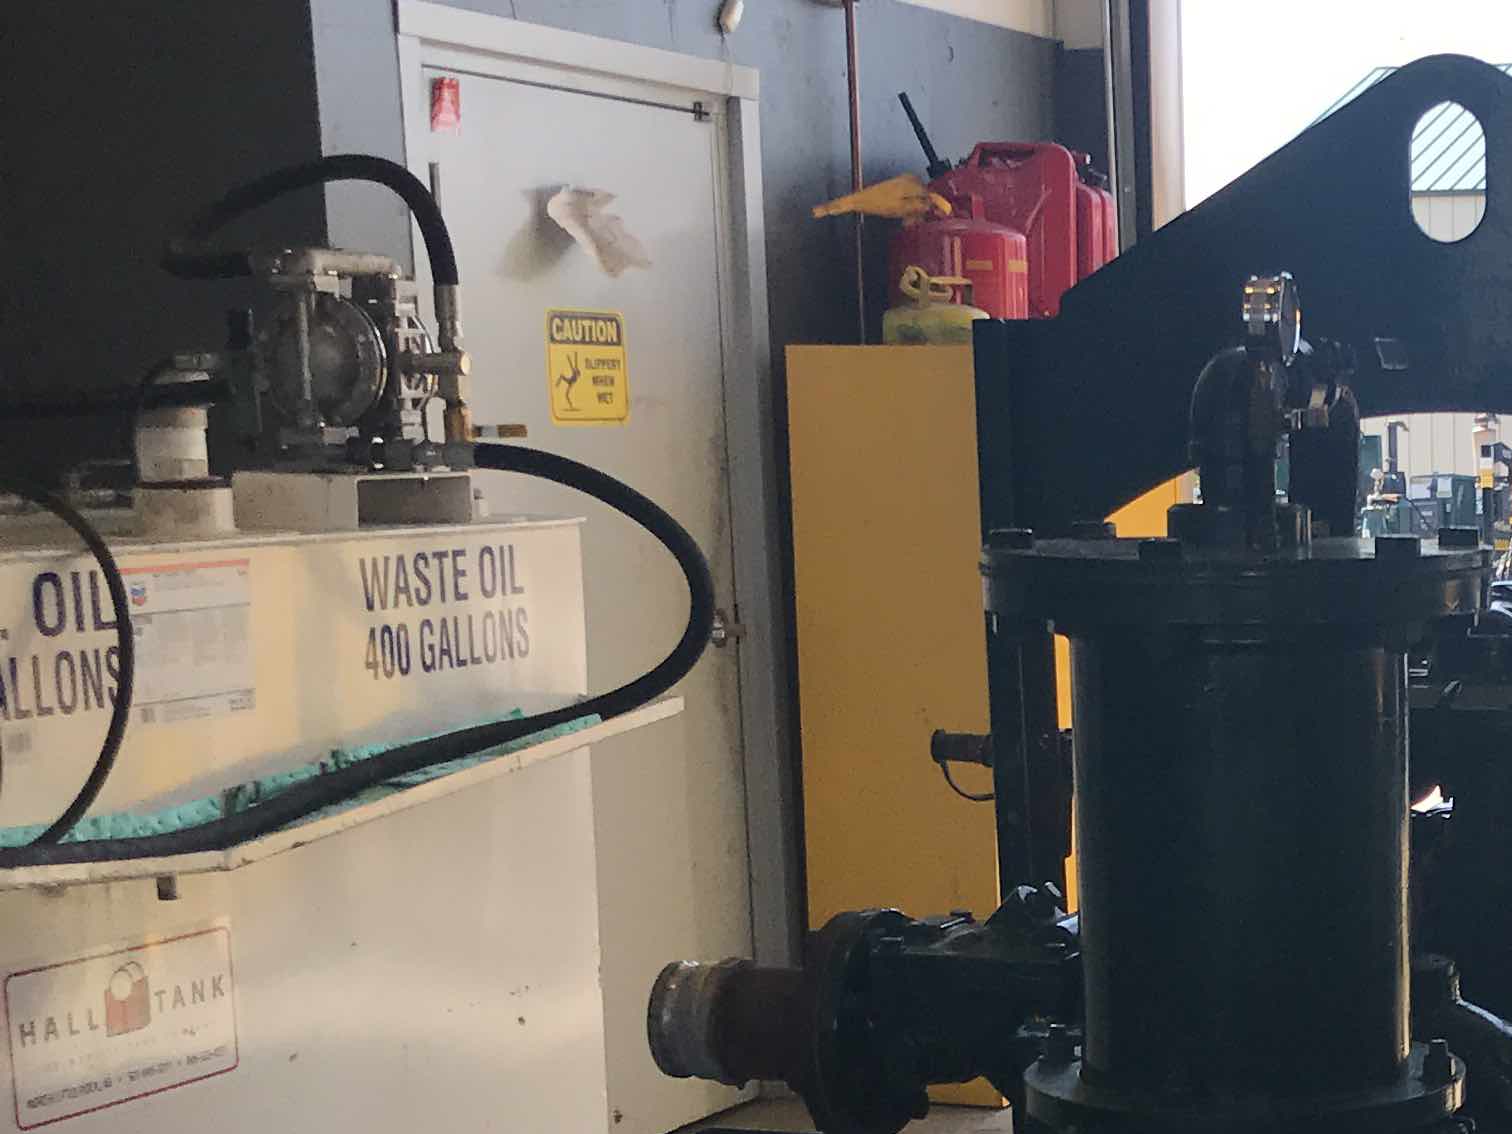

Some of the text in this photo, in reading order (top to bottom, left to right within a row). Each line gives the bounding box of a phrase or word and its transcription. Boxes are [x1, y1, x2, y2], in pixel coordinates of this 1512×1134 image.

[552, 318, 617, 342] CAUTION
[33, 570, 117, 637] OIL
[359, 543, 525, 612] WASTE OIL
[365, 606, 531, 680] 400 GALLONS
[18, 975, 225, 1048] HALL TANK
